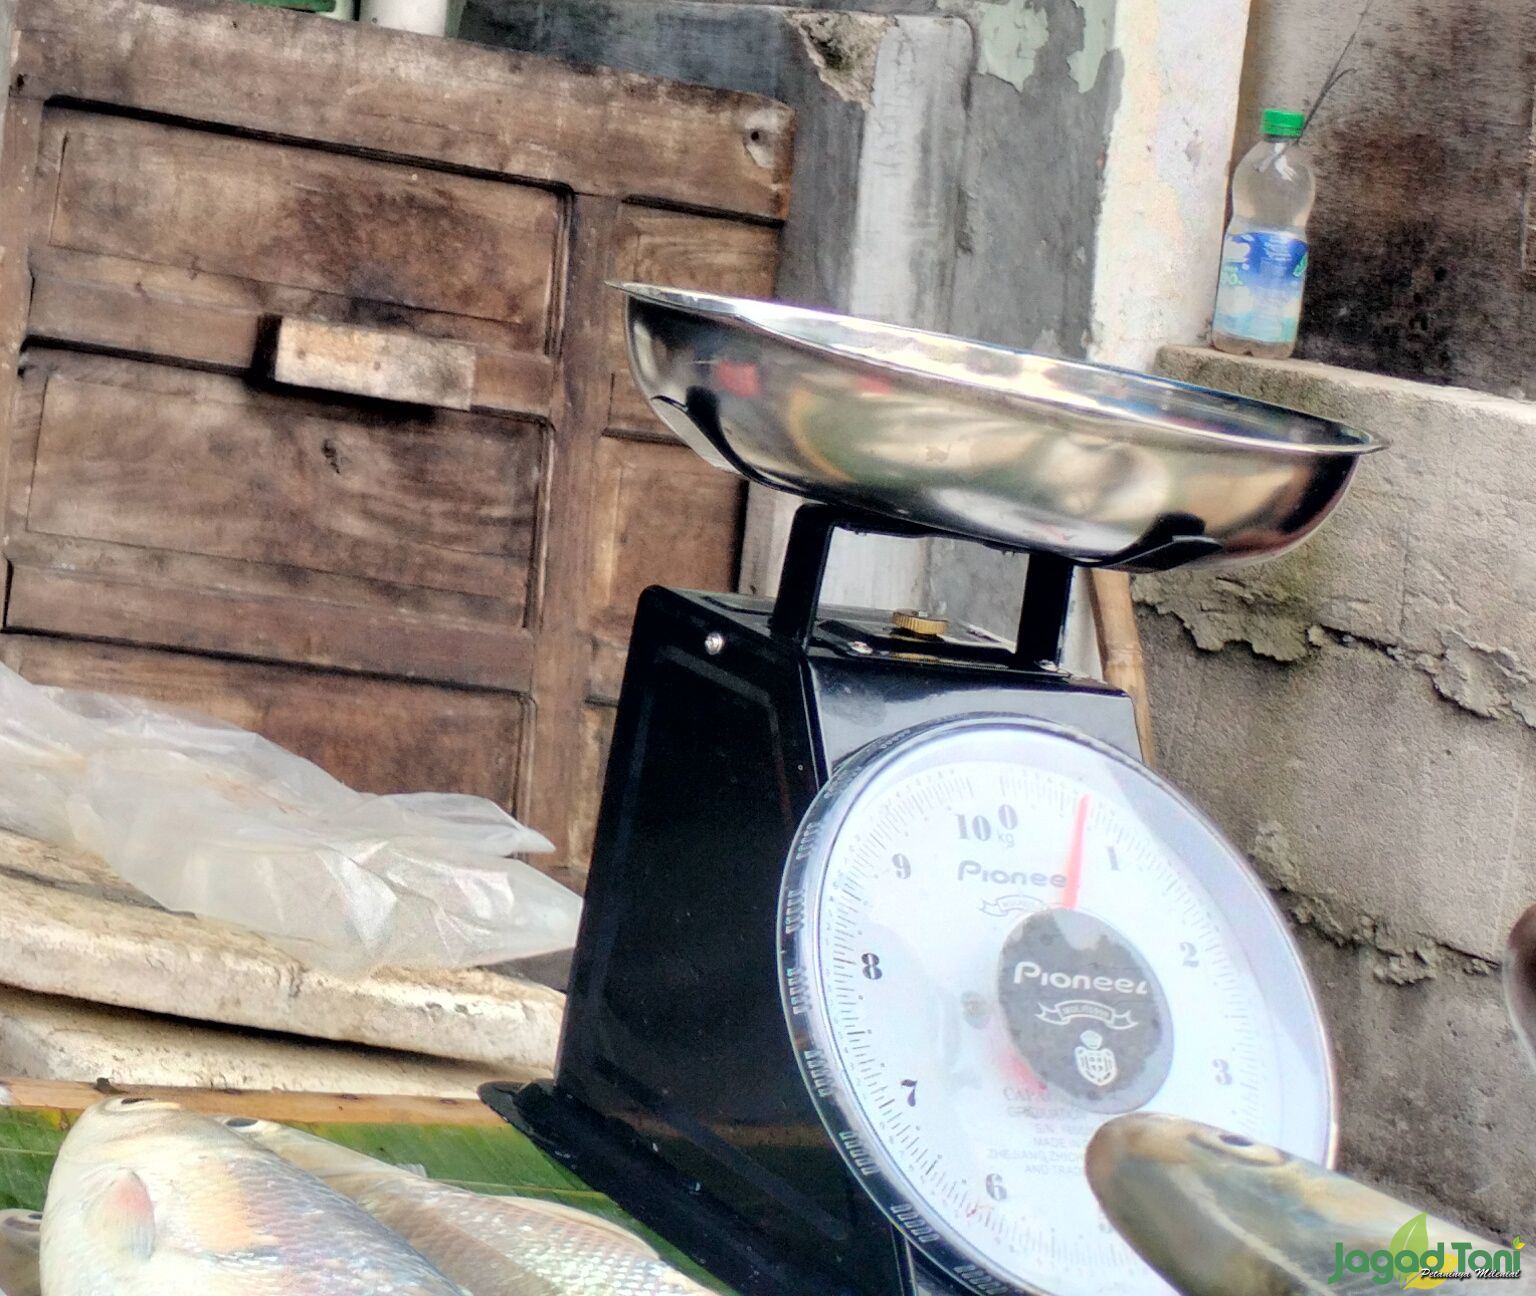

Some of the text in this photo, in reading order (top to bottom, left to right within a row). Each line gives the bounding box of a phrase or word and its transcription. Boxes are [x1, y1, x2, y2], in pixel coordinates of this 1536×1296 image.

[955, 813, 992, 842] 10
[997, 803, 1019, 831] 0
[891, 853, 912, 880] 9
[957, 859, 1067, 888] Pionee
[861, 952, 883, 980] 8
[1179, 941, 1201, 969] 2
[1212, 1057, 1233, 1086] 3
[900, 1078, 919, 1107] 7
[985, 1172, 1008, 1202] 6
